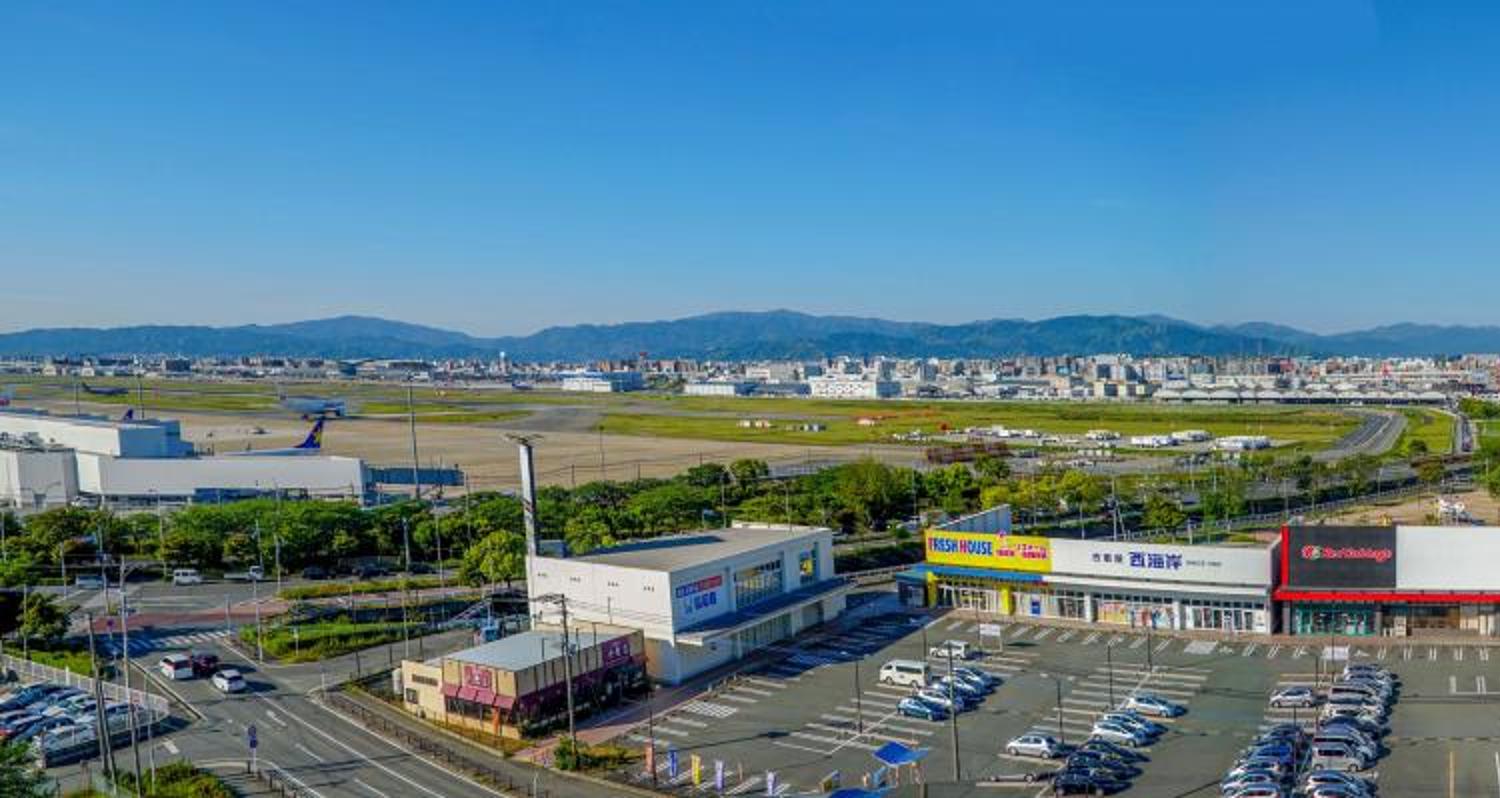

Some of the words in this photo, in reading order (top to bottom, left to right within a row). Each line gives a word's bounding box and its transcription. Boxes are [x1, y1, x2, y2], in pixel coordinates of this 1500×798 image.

[927, 537, 958, 553] FRESH
[959, 538, 993, 556] HOUSE
[1129, 551, 1182, 570] 西海岸
